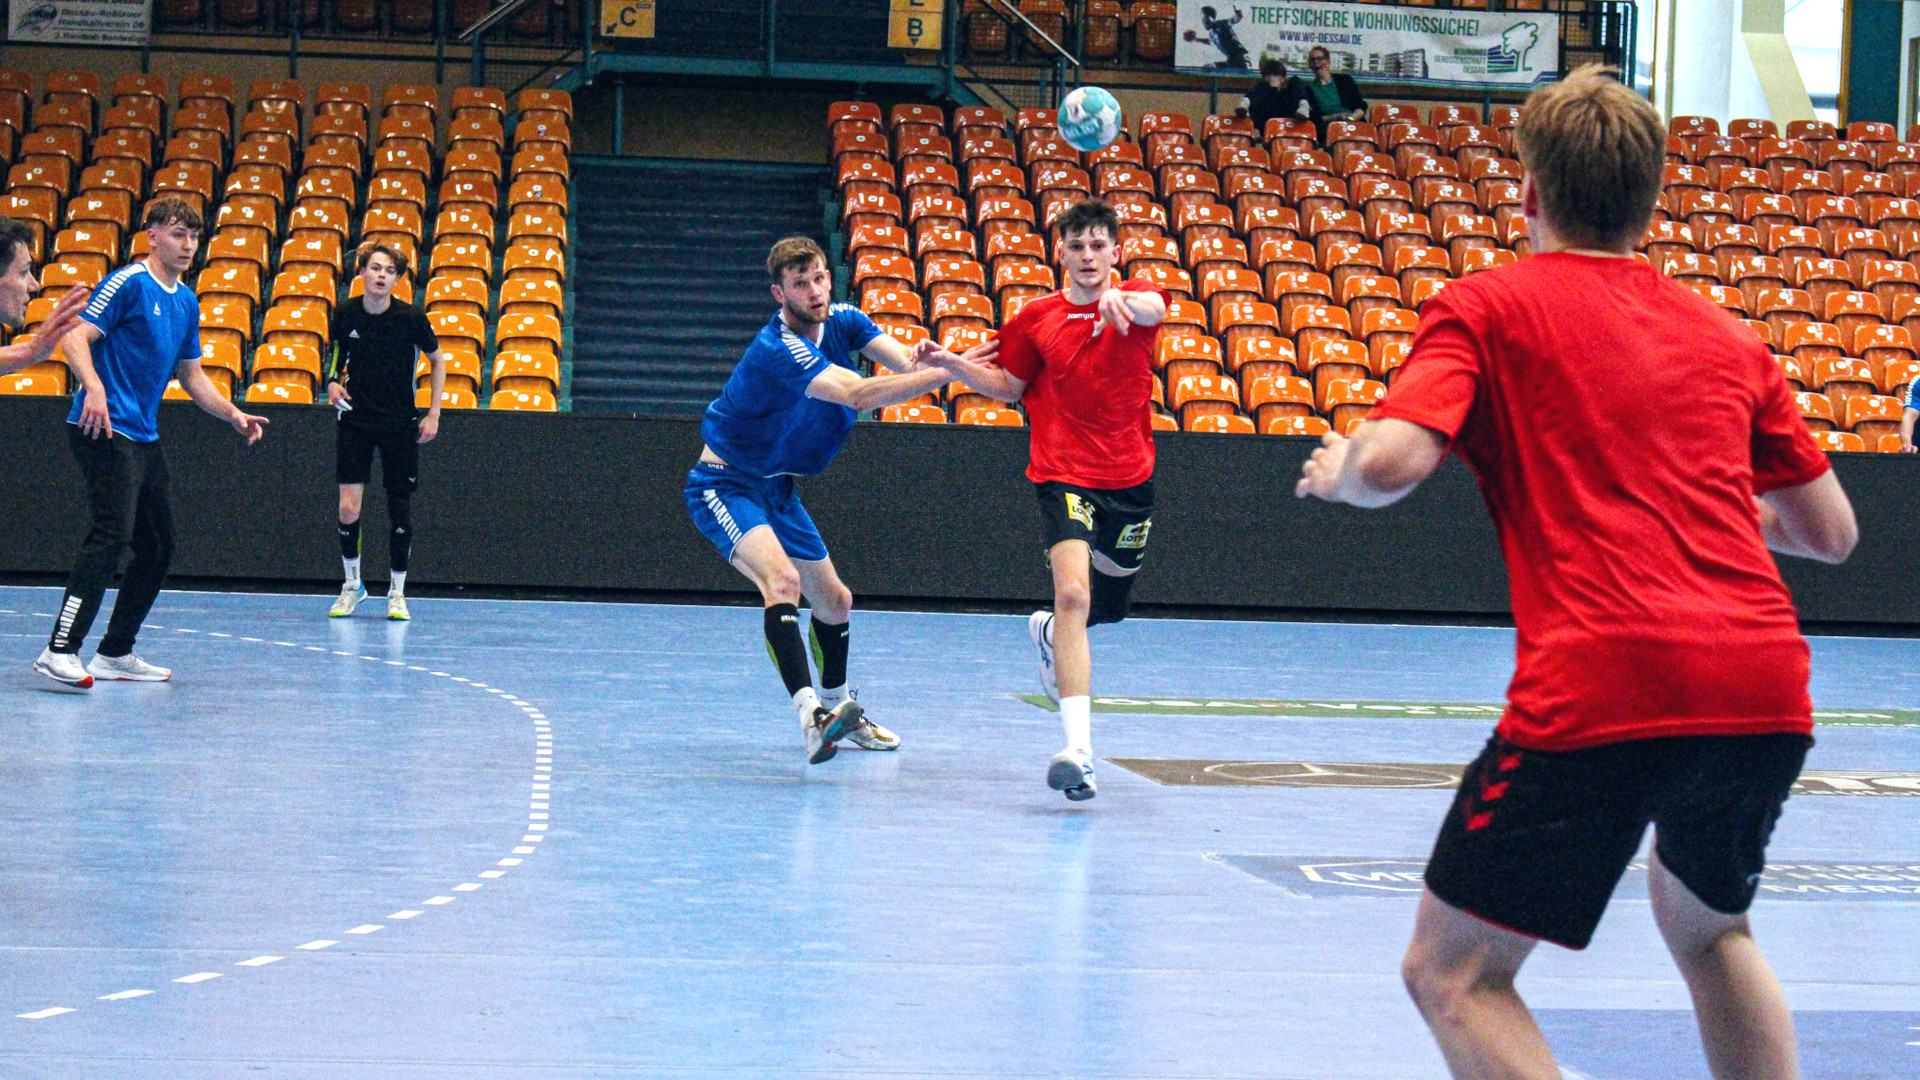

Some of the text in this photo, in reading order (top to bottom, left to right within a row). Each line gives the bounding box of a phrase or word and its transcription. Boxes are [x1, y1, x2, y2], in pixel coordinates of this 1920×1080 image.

[620, 7, 636, 26] C
[1251, 6, 1479, 37] TREFFSICHERE WOHNUNGSSUCHE!
[908, 18, 923, 37] B
[1279, 30, 1362, 45] WWW.WG-DESSAU.DE
